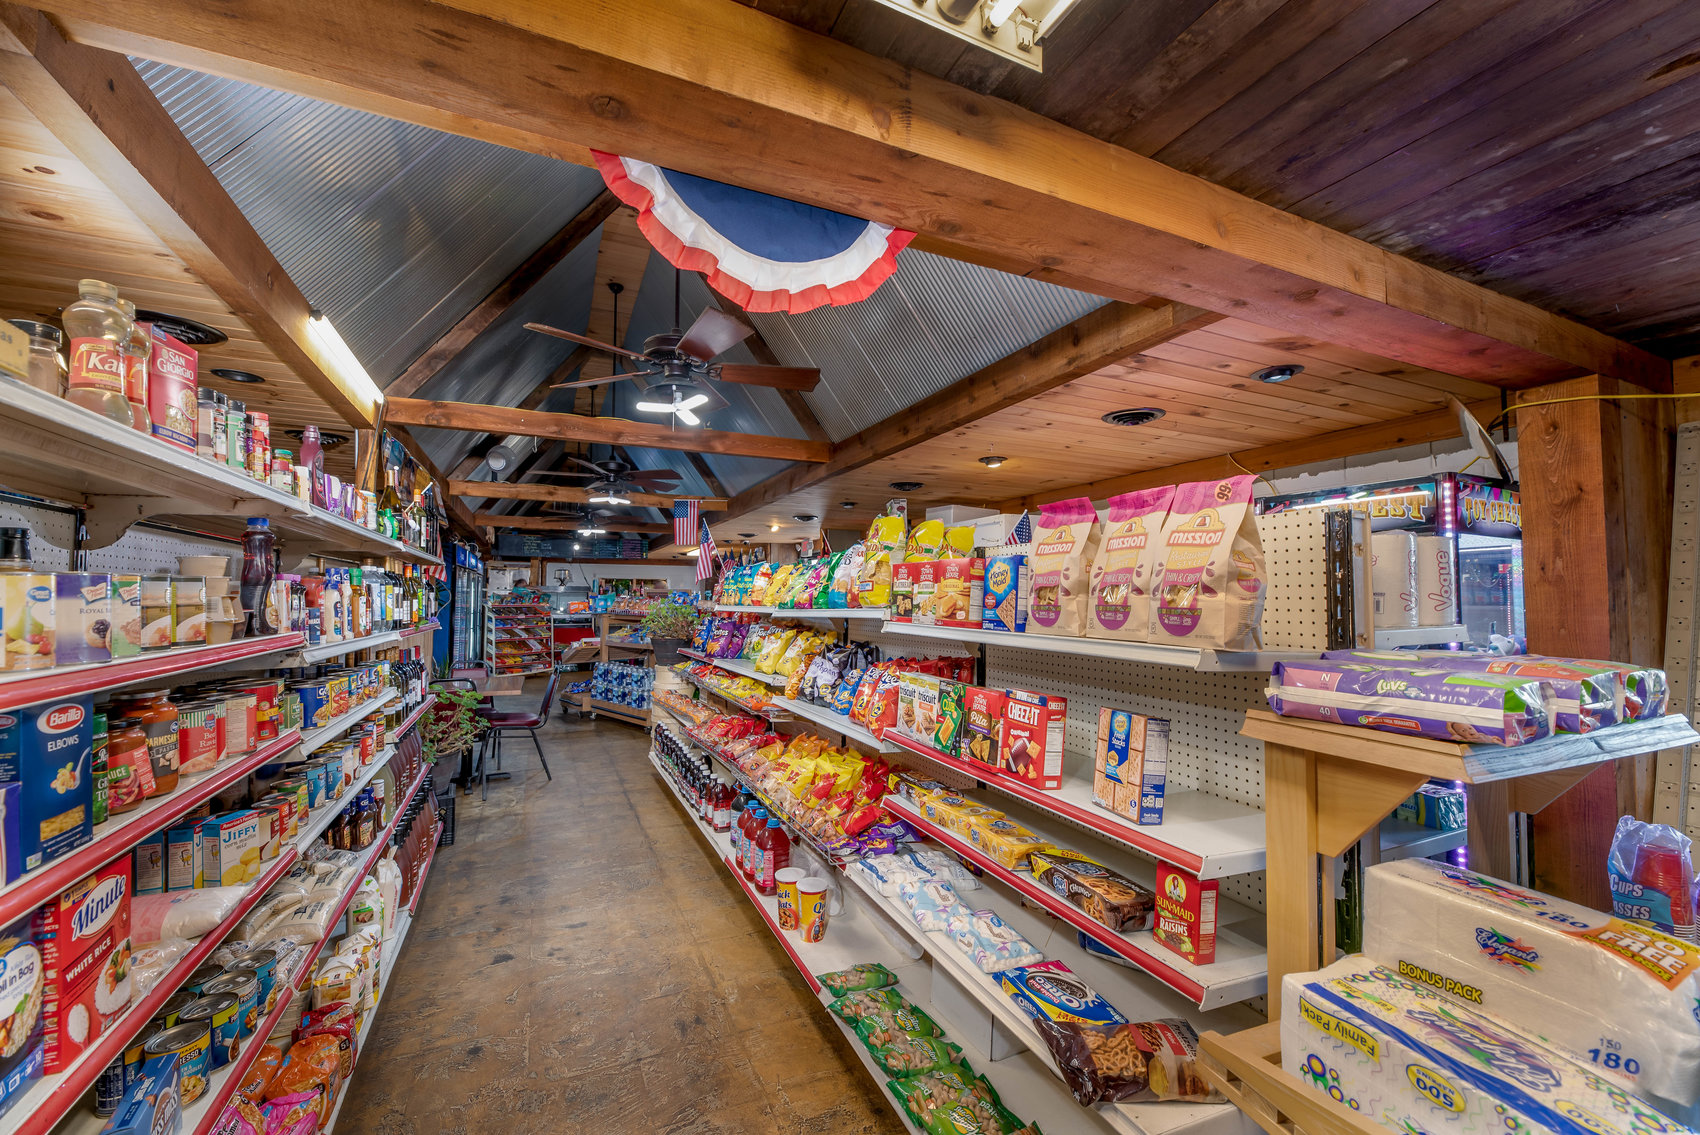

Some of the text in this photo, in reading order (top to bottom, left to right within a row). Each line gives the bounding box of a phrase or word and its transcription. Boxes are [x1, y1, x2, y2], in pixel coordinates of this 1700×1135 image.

[168, 350, 186, 367] SAN
[156, 357, 194, 380] GIORGIO
[1465, 497, 1487, 527] TOY
[1107, 534, 1146, 550] MISSION
[1169, 531, 1223, 545] MISSION
[1037, 543, 1072, 555] MISSION
[946, 565, 959, 573] TOWN
[990, 568, 1009, 580] Honey
[1166, 572, 1179, 582] THIN
[1183, 572, 1201, 583] CRISPY
[992, 578, 1007, 588] Maid
[1428, 550, 1450, 612] Vogue
[1321, 672, 1330, 682] N
[918, 691, 937, 705] triscuit
[49, 708, 82, 727] Barilla
[970, 711, 989, 727] Pita
[1008, 701, 1040, 726] CHEEZ-IT
[1319, 707, 1331, 716] 40
[48, 734, 79, 752] ELBOWS
[1070, 882, 1092, 898] CHUNKY
[72, 875, 127, 941] Minute
[1156, 895, 1195, 922] SUN-MAID
[1614, 901, 1650, 920] ASSES
[1160, 917, 1188, 936] RAISINS
[1476, 927, 1538, 963] Elegant
[1598, 931, 1688, 975] FREE
[66, 936, 112, 982] WHITE RICE
[1633, 955, 1673, 982] INSIDE
[18, 961, 34, 981] Bag
[1399, 960, 1482, 1004] BONUS PACK
[1035, 975, 1080, 1009] OREO
[1019, 996, 1038, 1016] OREO
[1302, 1005, 1376, 1059] Family Pack
[1588, 1048, 1640, 1075] 180
[1416, 1076, 1455, 1109] 500
